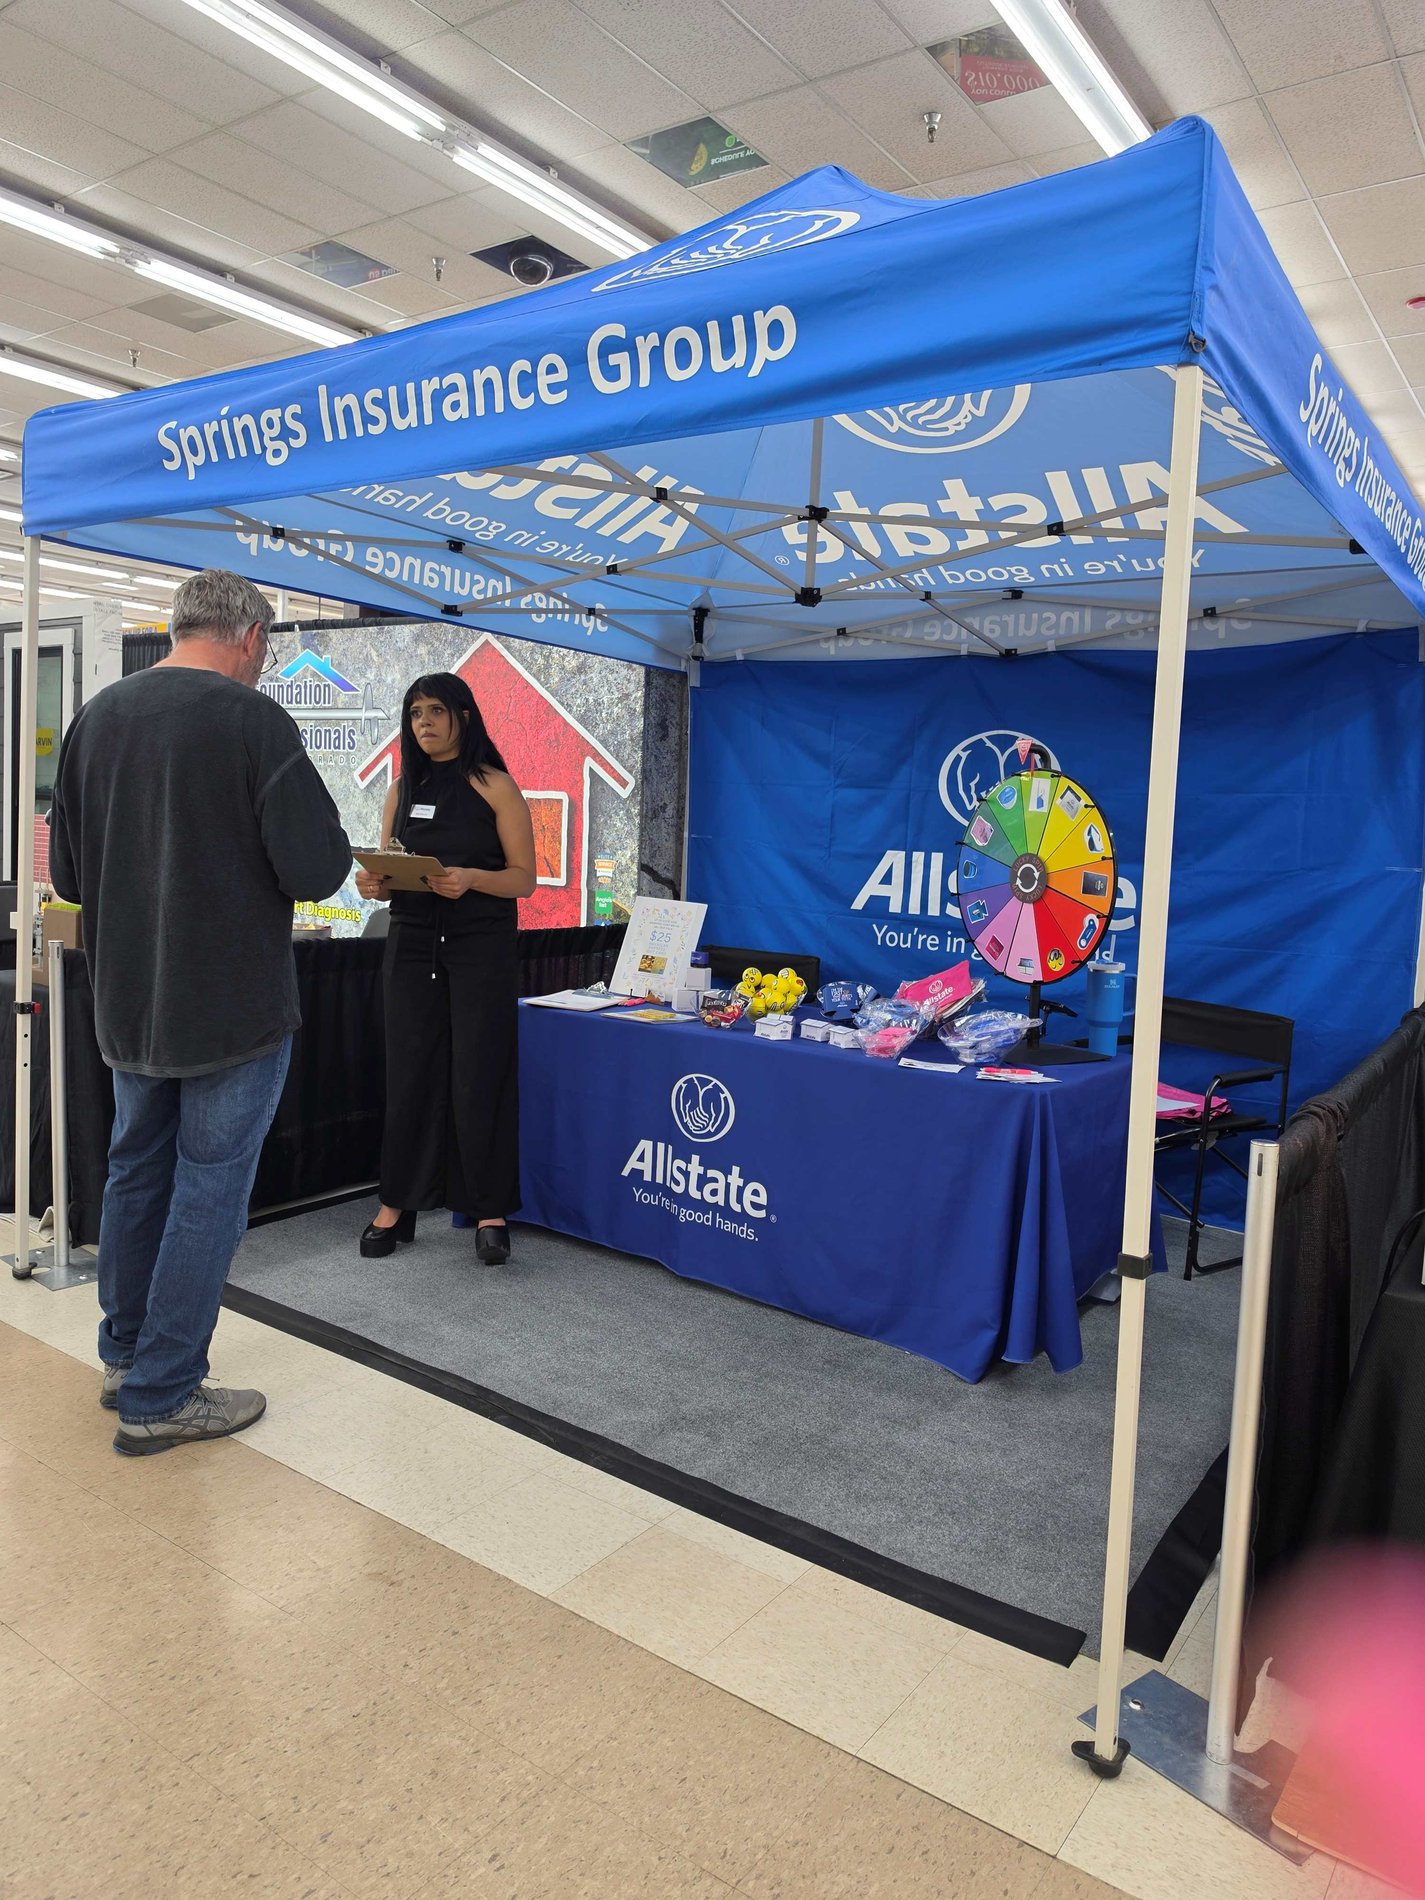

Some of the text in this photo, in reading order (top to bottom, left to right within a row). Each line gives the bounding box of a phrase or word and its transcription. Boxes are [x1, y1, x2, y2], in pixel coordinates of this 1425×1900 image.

[157, 304, 797, 481] Springs Insurance Group
[1300, 353, 1425, 593] Springs Insurance Gro
[259, 680, 331, 705] oundation
[300, 724, 356, 751] sionals
[306, 901, 361, 922] Diagnosis
[650, 930, 672, 943] $25
[873, 924, 966, 953] You're in
[923, 986, 954, 1006] Allstate
[621, 1139, 768, 1218] Allstate
[632, 1187, 671, 1211] You're
[679, 1207, 712, 1226] good
[716, 1213, 759, 1242] hands.
